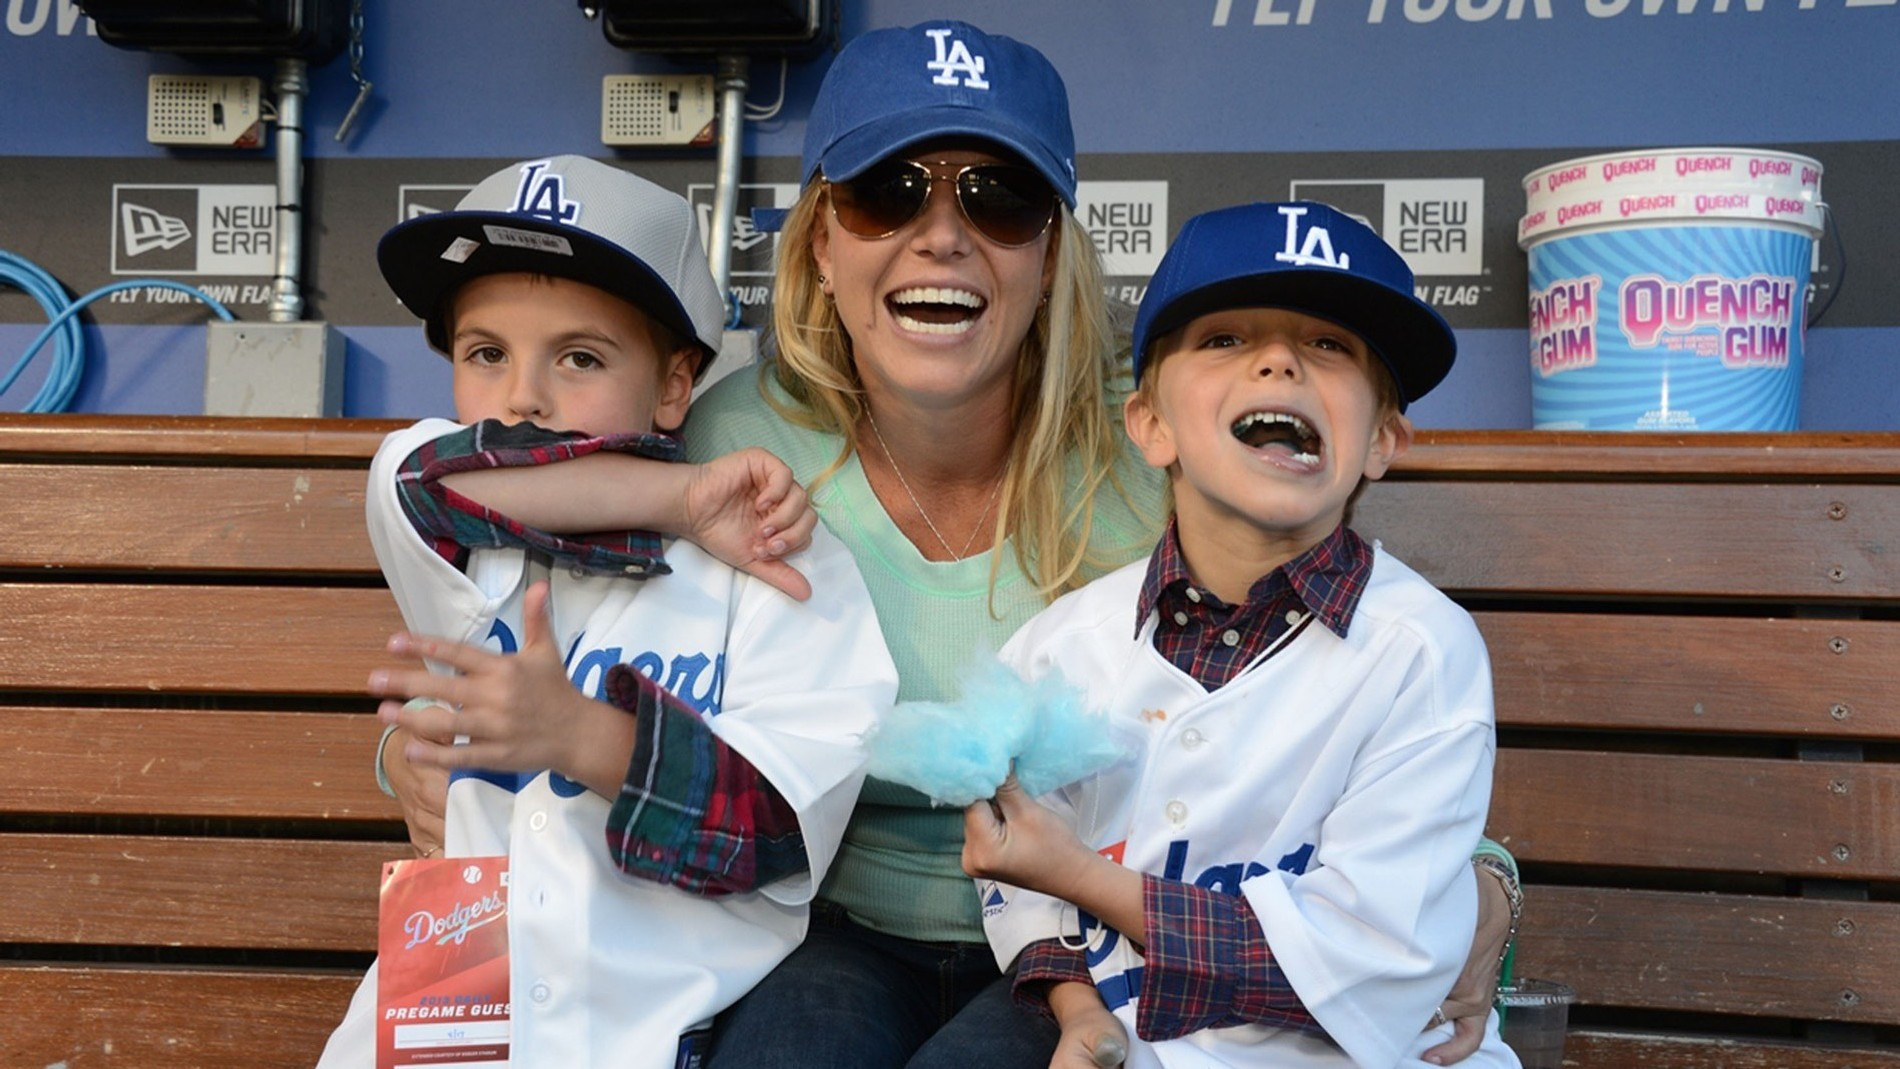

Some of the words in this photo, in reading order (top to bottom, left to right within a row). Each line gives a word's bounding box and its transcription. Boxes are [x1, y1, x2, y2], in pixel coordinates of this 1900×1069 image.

[925, 29, 990, 90] LA
[1548, 165, 1587, 192] QUENCH
[1603, 157, 1656, 182] QUENCH
[1676, 156, 1732, 176] QUENCH
[1749, 158, 1792, 178] QUENCH
[506, 160, 580, 226] LA
[212, 206, 273, 228] NEW
[1088, 203, 1152, 227] NEW
[1400, 201, 1467, 226] NEW
[1557, 200, 1603, 225] QUENCH
[1619, 195, 1675, 217] QUENCH
[1695, 195, 1749, 214] QUENCH
[1765, 197, 1804, 216] QUENCH
[212, 231, 272, 255] ERA
[1088, 229, 1152, 254] ERA
[1275, 206, 1350, 270] LA
[1400, 228, 1466, 253] ERA
[240, 284, 276, 304] FLA
[728, 286, 769, 306] OUR
[1431, 285, 1480, 306] FLAG
[1624, 277, 1791, 346] QUENCH
[1540, 325, 1594, 376] GUM
[1724, 325, 1788, 365] GUM
[404, 891, 510, 950] Dodgers
[385, 1005, 465, 1020] PREGAME
[470, 1002, 511, 1017] GUES
